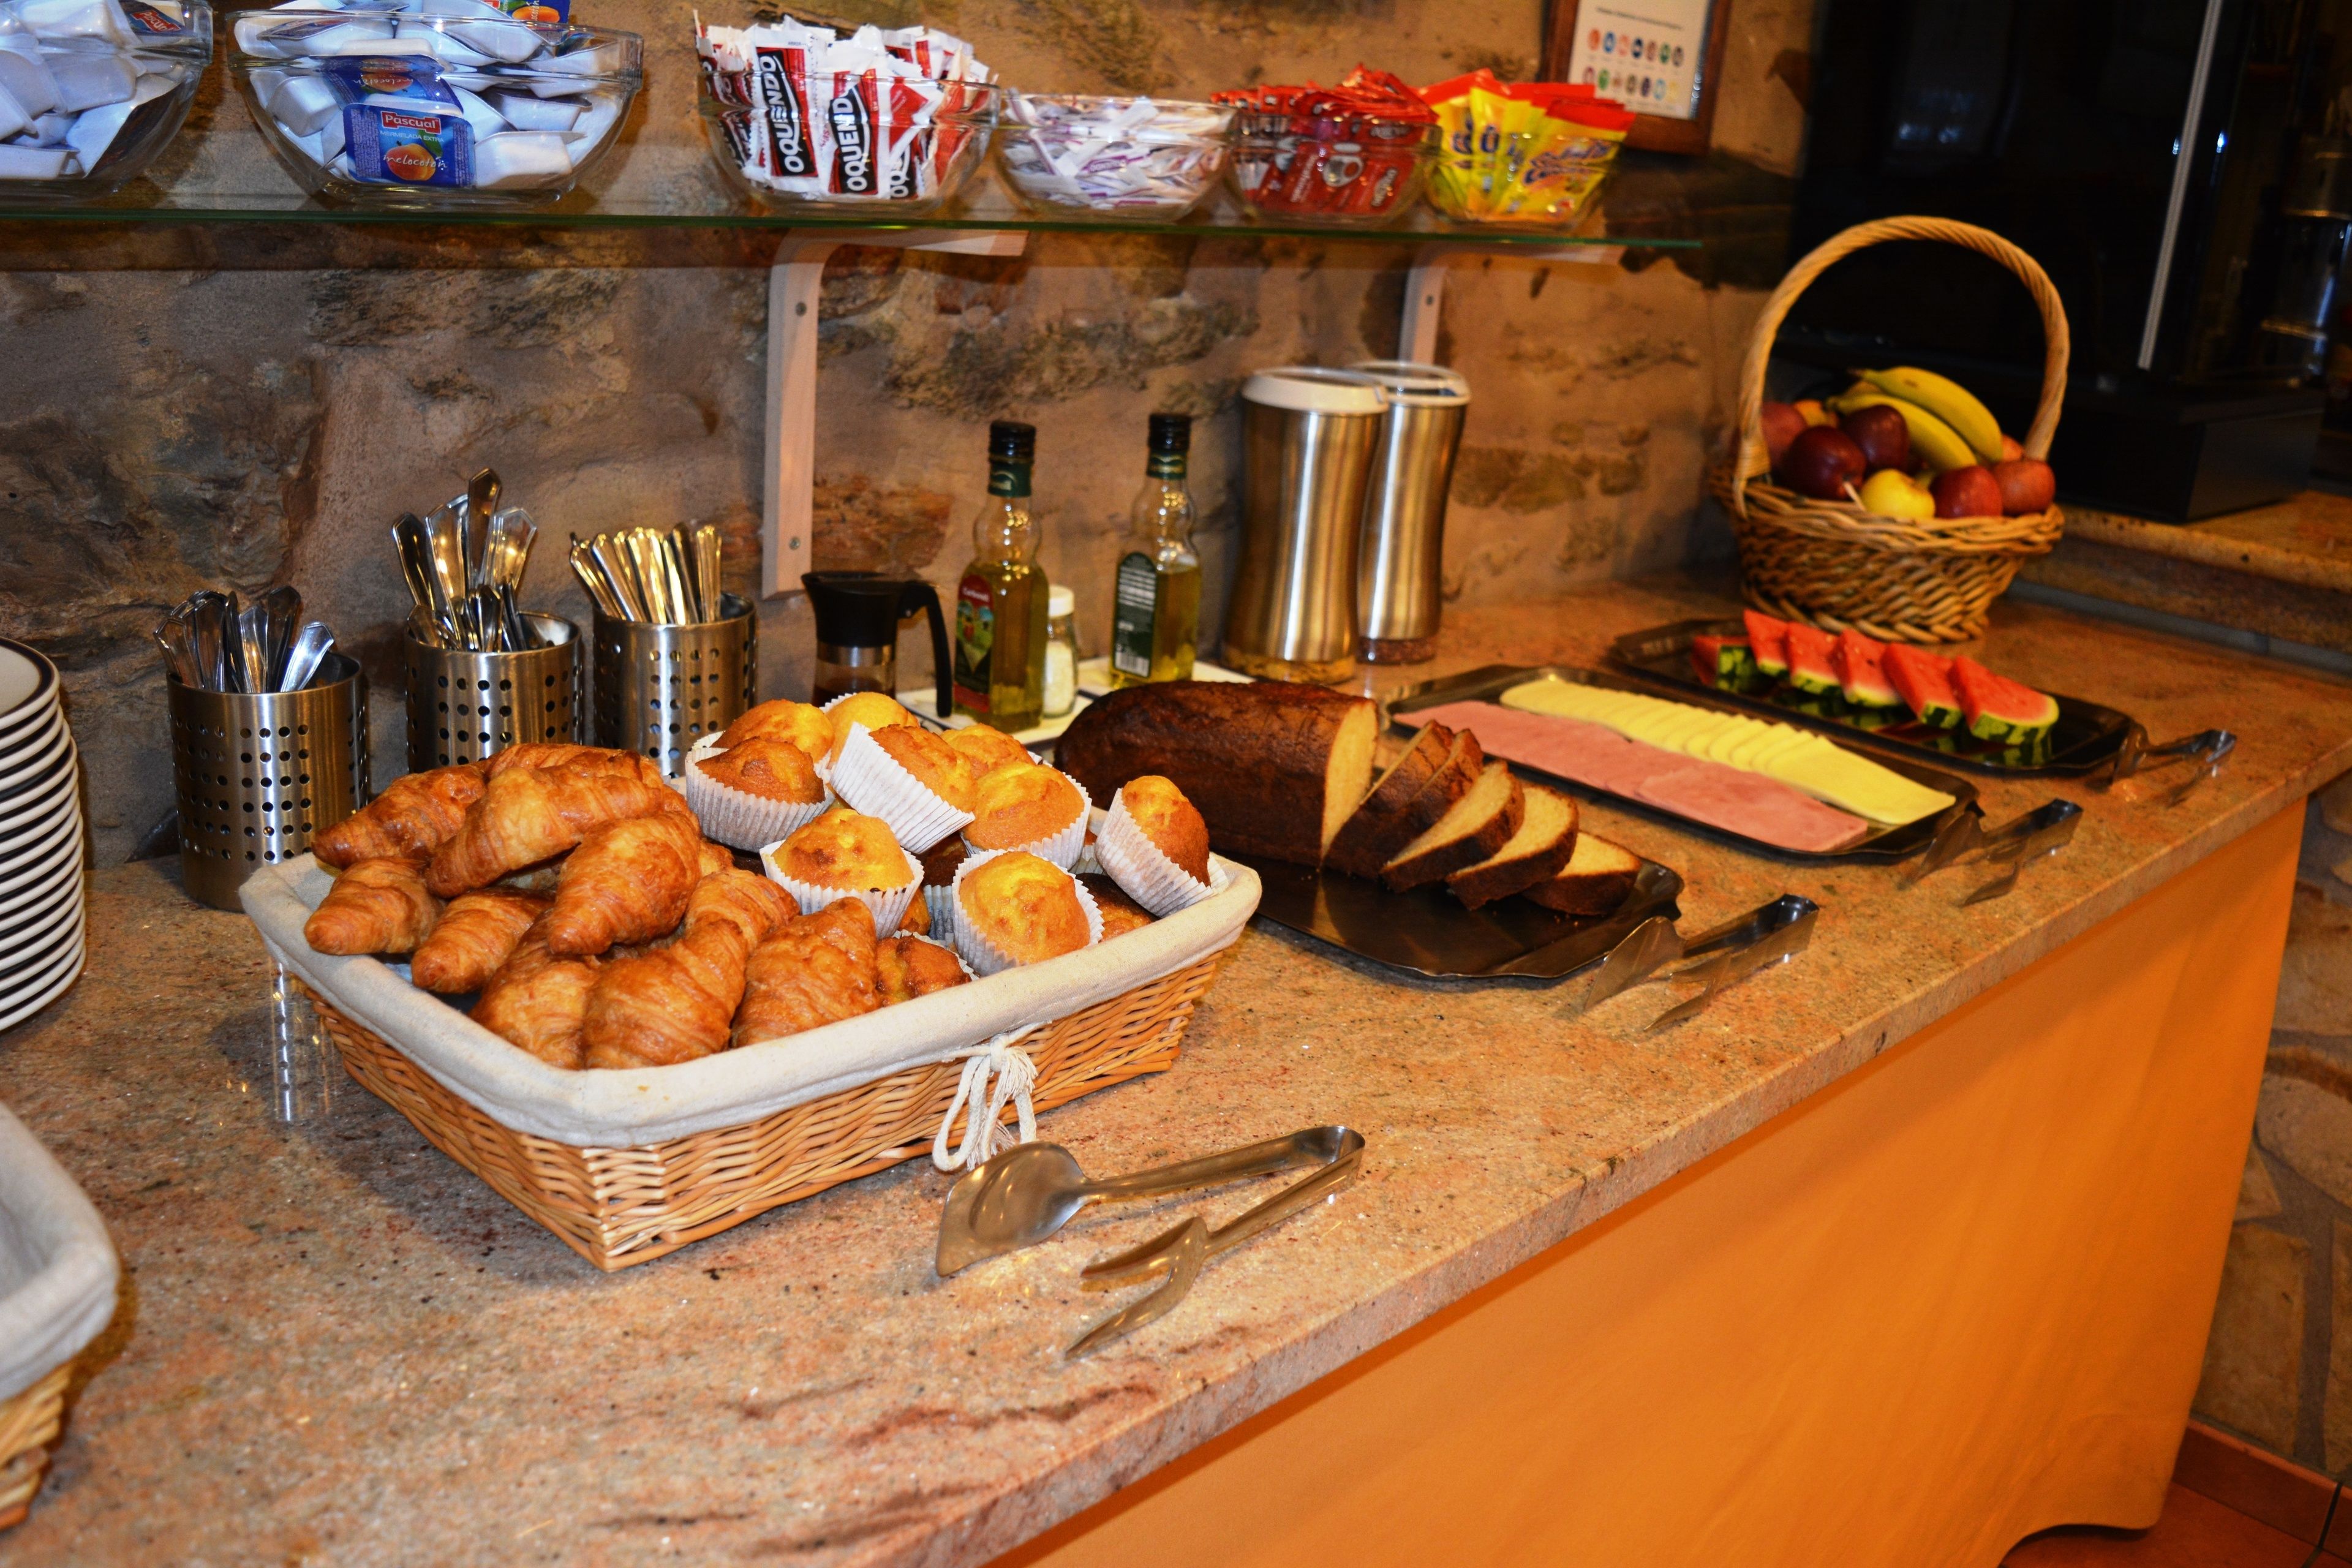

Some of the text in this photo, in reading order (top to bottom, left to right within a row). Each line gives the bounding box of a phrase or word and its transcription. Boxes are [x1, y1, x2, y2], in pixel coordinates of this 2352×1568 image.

[758, 55, 805, 173] OQUENDO
[385, 115, 435, 129] Pascual
[380, 130, 422, 140] MERMELADA
[832, 97, 868, 191] OQUEND
[383, 154, 448, 169] melocotón
